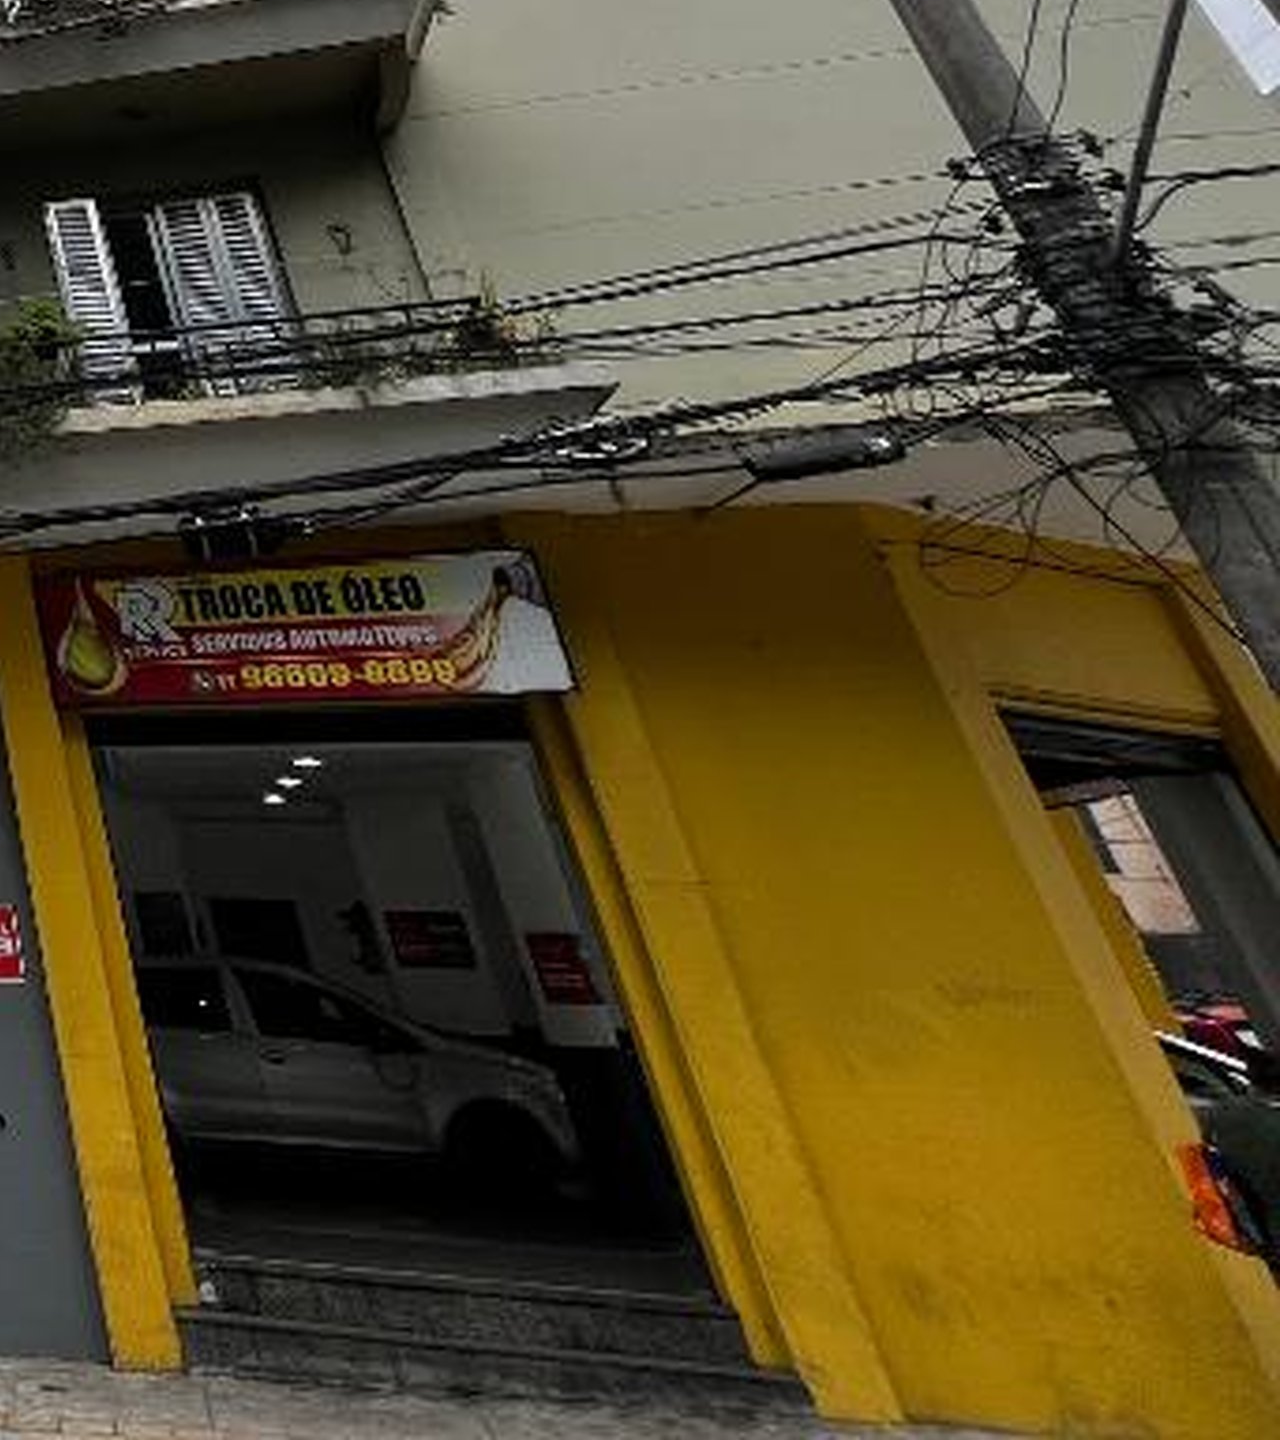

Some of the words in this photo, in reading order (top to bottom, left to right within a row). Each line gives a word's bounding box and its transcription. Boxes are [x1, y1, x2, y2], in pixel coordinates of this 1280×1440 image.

[178, 581, 287, 621] TROCA
[292, 580, 336, 615] DE
[341, 571, 427, 613] ÓLEO
